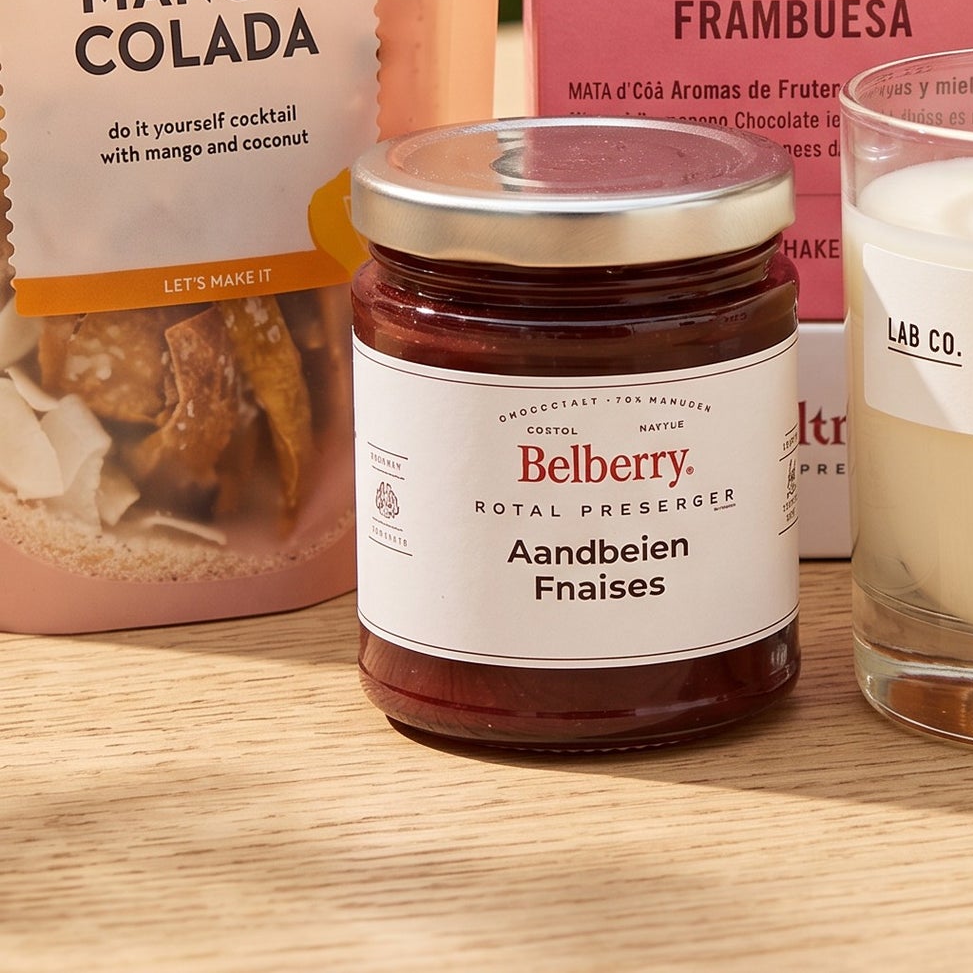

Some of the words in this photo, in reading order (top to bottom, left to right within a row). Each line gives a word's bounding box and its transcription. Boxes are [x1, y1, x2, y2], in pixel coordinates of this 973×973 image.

[674, 0, 913, 40] FRAMBUESA
[74, 7, 320, 76] COLADA
[568, 82, 612, 100] MATA
[671, 80, 741, 100] Aromas
[748, 80, 771, 99] de
[108, 122, 131, 139] do
[135, 120, 149, 137] it
[153, 111, 226, 139] yourself
[230, 104, 297, 128] cocktail
[735, 111, 820, 129] Chocolate
[100, 145, 140, 165] with
[145, 143, 202, 162] mango
[207, 135, 238, 154] and
[242, 129, 309, 151] coconut
[164, 276, 206, 294] LET'S
[210, 271, 254, 288] MAKE
[258, 268, 272, 282] IT
[888, 317, 920, 348] LAB
[929, 329, 962, 357] CO.
[527, 425, 578, 435] COSTOL
[800, 463, 846, 475] PRE
[475, 500, 561, 518] ROTAL
[581, 488, 735, 518] PRESERGER
[507, 534, 689, 565] Aandbeien
[535, 572, 666, 601] Fnaises
